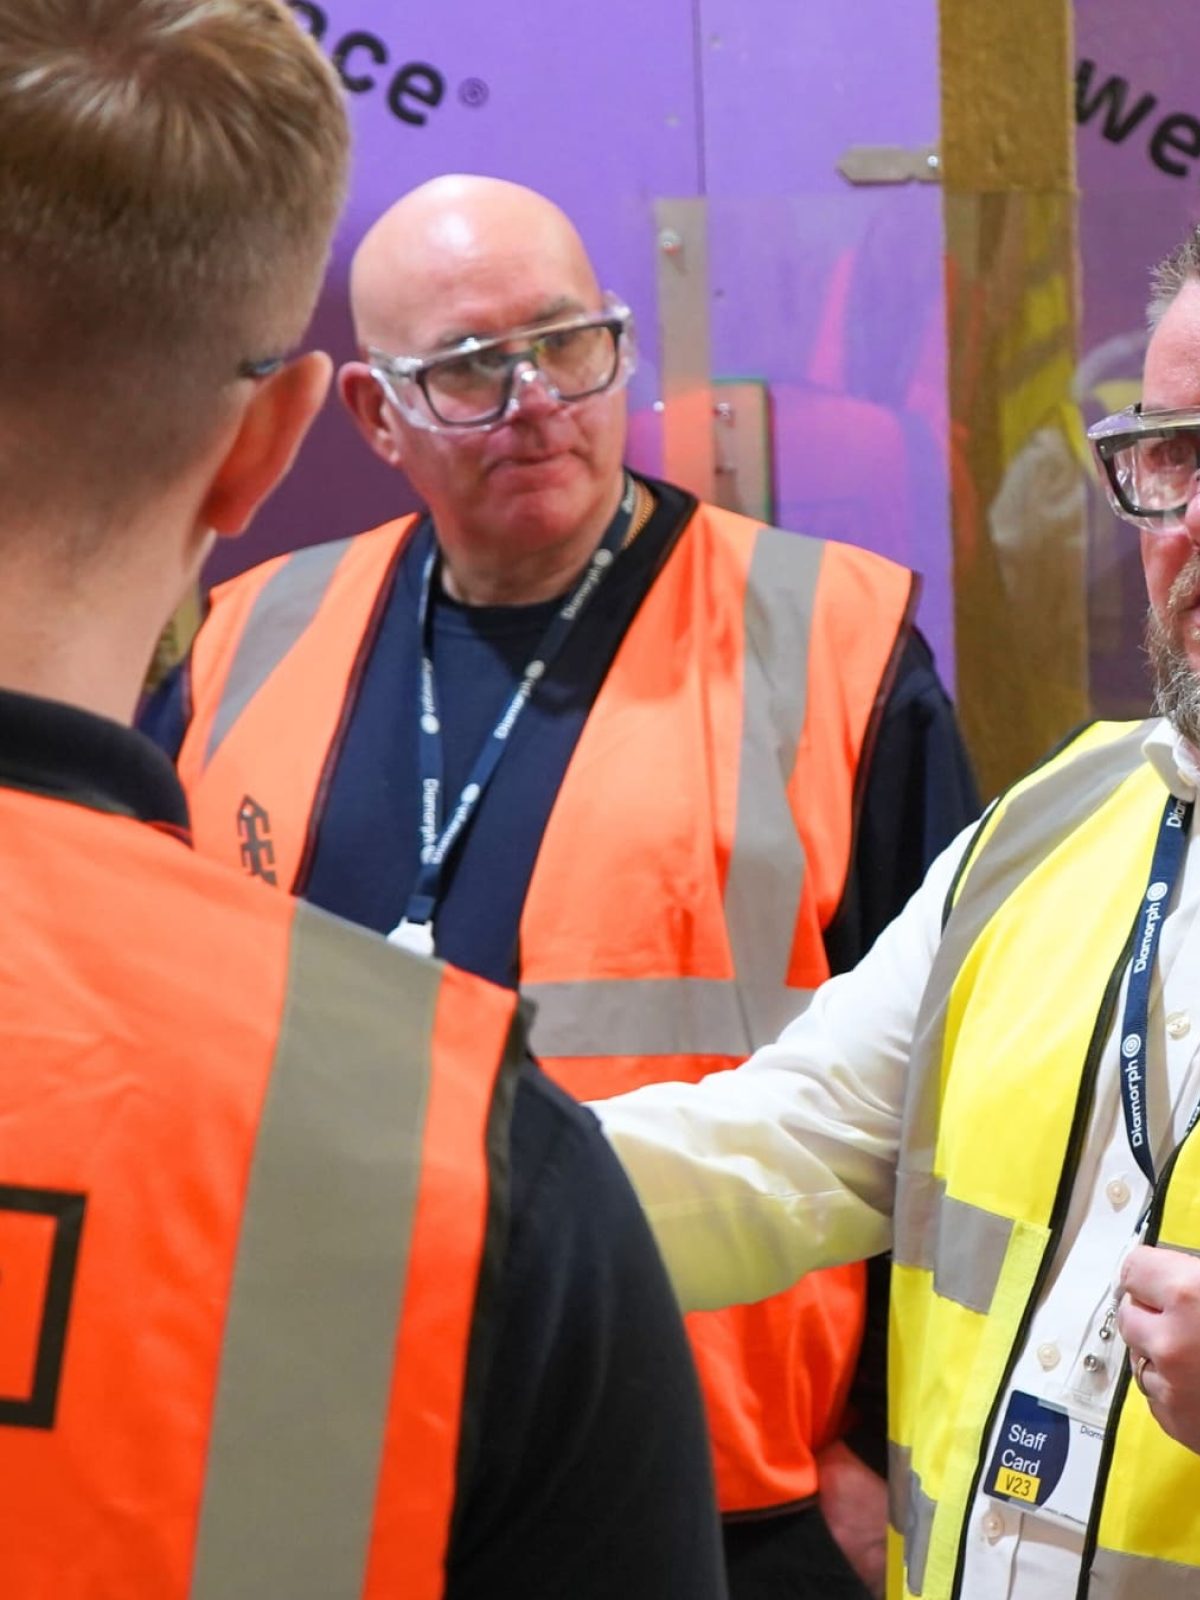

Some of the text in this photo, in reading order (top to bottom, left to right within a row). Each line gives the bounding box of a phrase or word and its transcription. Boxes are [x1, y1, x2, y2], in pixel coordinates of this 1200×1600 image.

[1134, 900, 1161, 974] Diamorph
[1123, 1058, 1144, 1147] Diamorph
[1008, 1424, 1047, 1451] Staff
[1001, 1450, 1040, 1475] Card
[1005, 1474, 1031, 1496] V23
